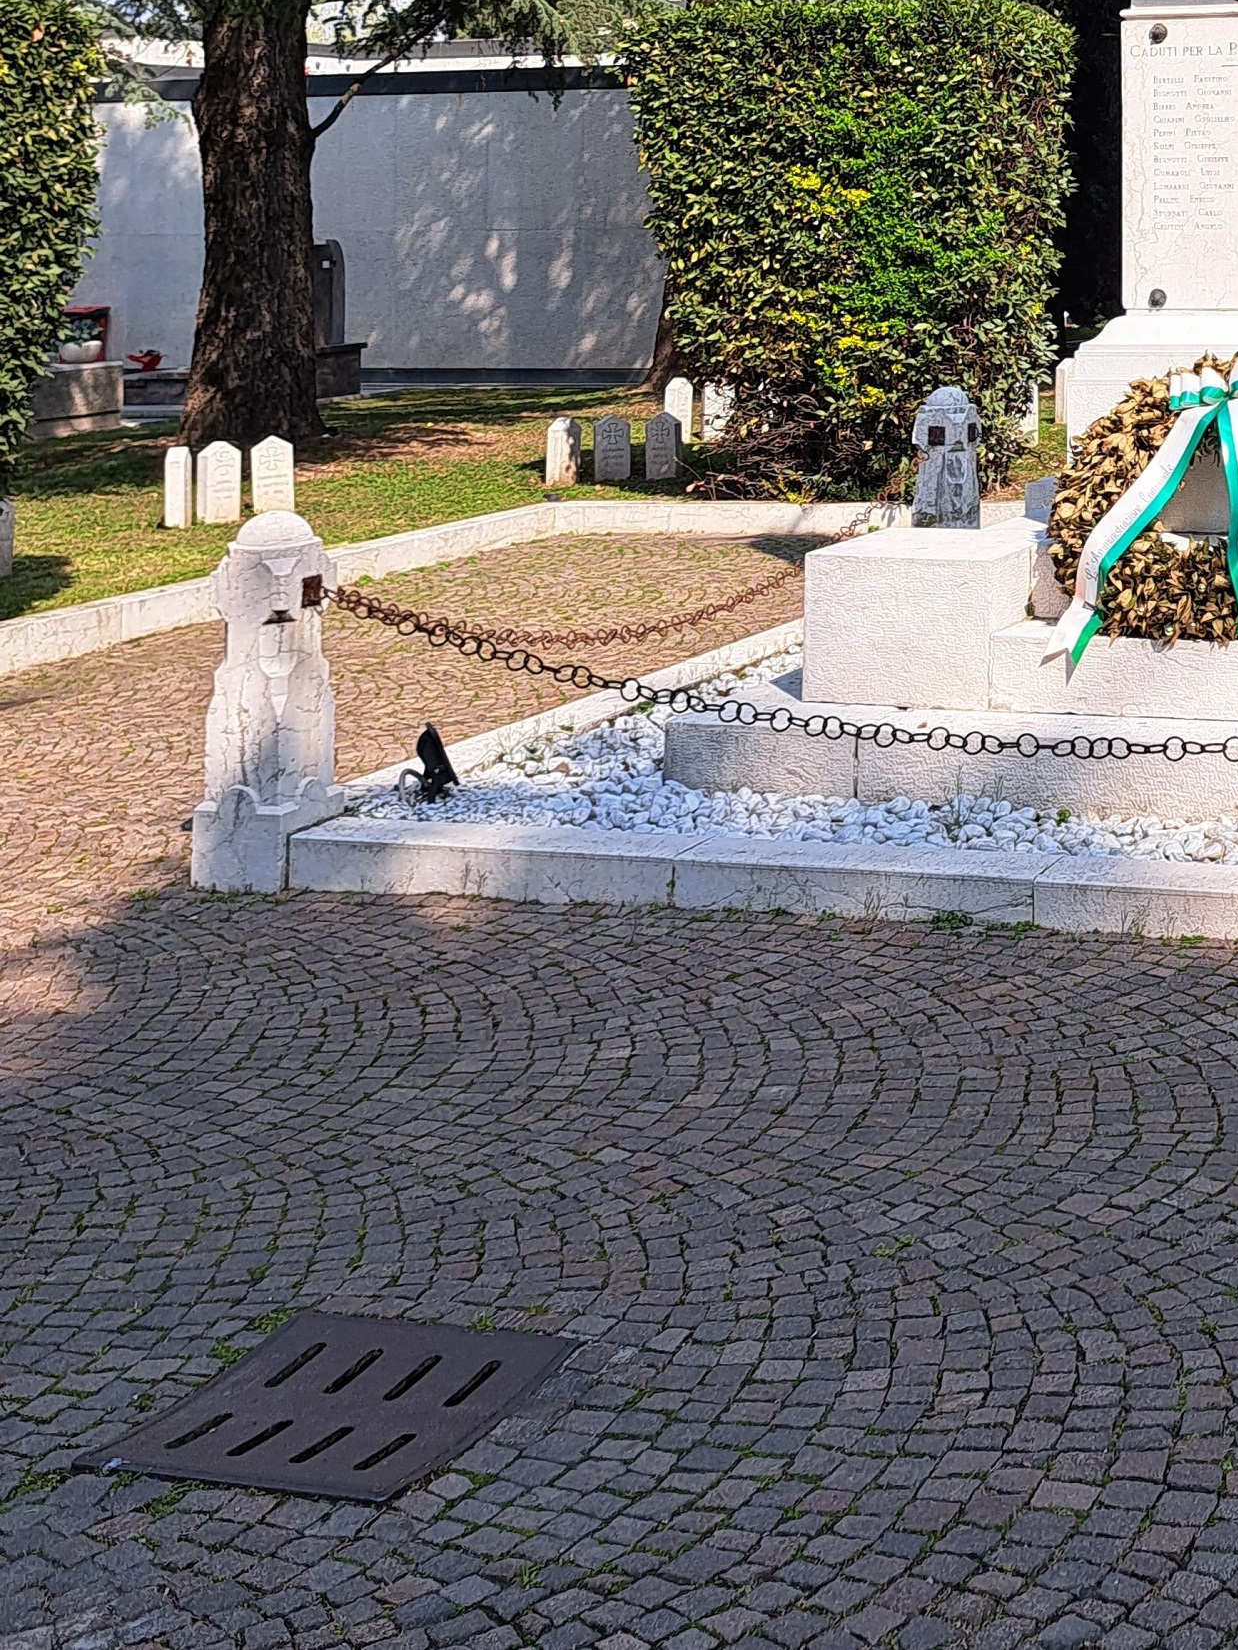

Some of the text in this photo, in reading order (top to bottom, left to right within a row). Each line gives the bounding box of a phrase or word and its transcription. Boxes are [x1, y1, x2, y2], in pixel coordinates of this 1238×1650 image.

[1129, 45, 1177, 57] CADUTI
[1182, 45, 1203, 56] PER
[1208, 45, 1223, 55] LA
[1196, 87, 1232, 96] GIOVANNI
[1185, 101, 1215, 110] ANDREA
[1194, 114, 1236, 123] GUGLIELMO
[1185, 127, 1211, 136] PIETRO
[1197, 154, 1229, 163] GIUSEPPE
[1153, 168, 1191, 177] COMAROLI
[1200, 167, 1220, 176] LUIGI
[1153, 182, 1190, 190] LOMBARDI
[1198, 181, 1235, 190] GIOVANNI
[1198, 208, 1223, 216] CARLO
[1193, 221, 1224, 230] ANGELO
[1085, 463, 1175, 582] L'Amministrazione Comunale
